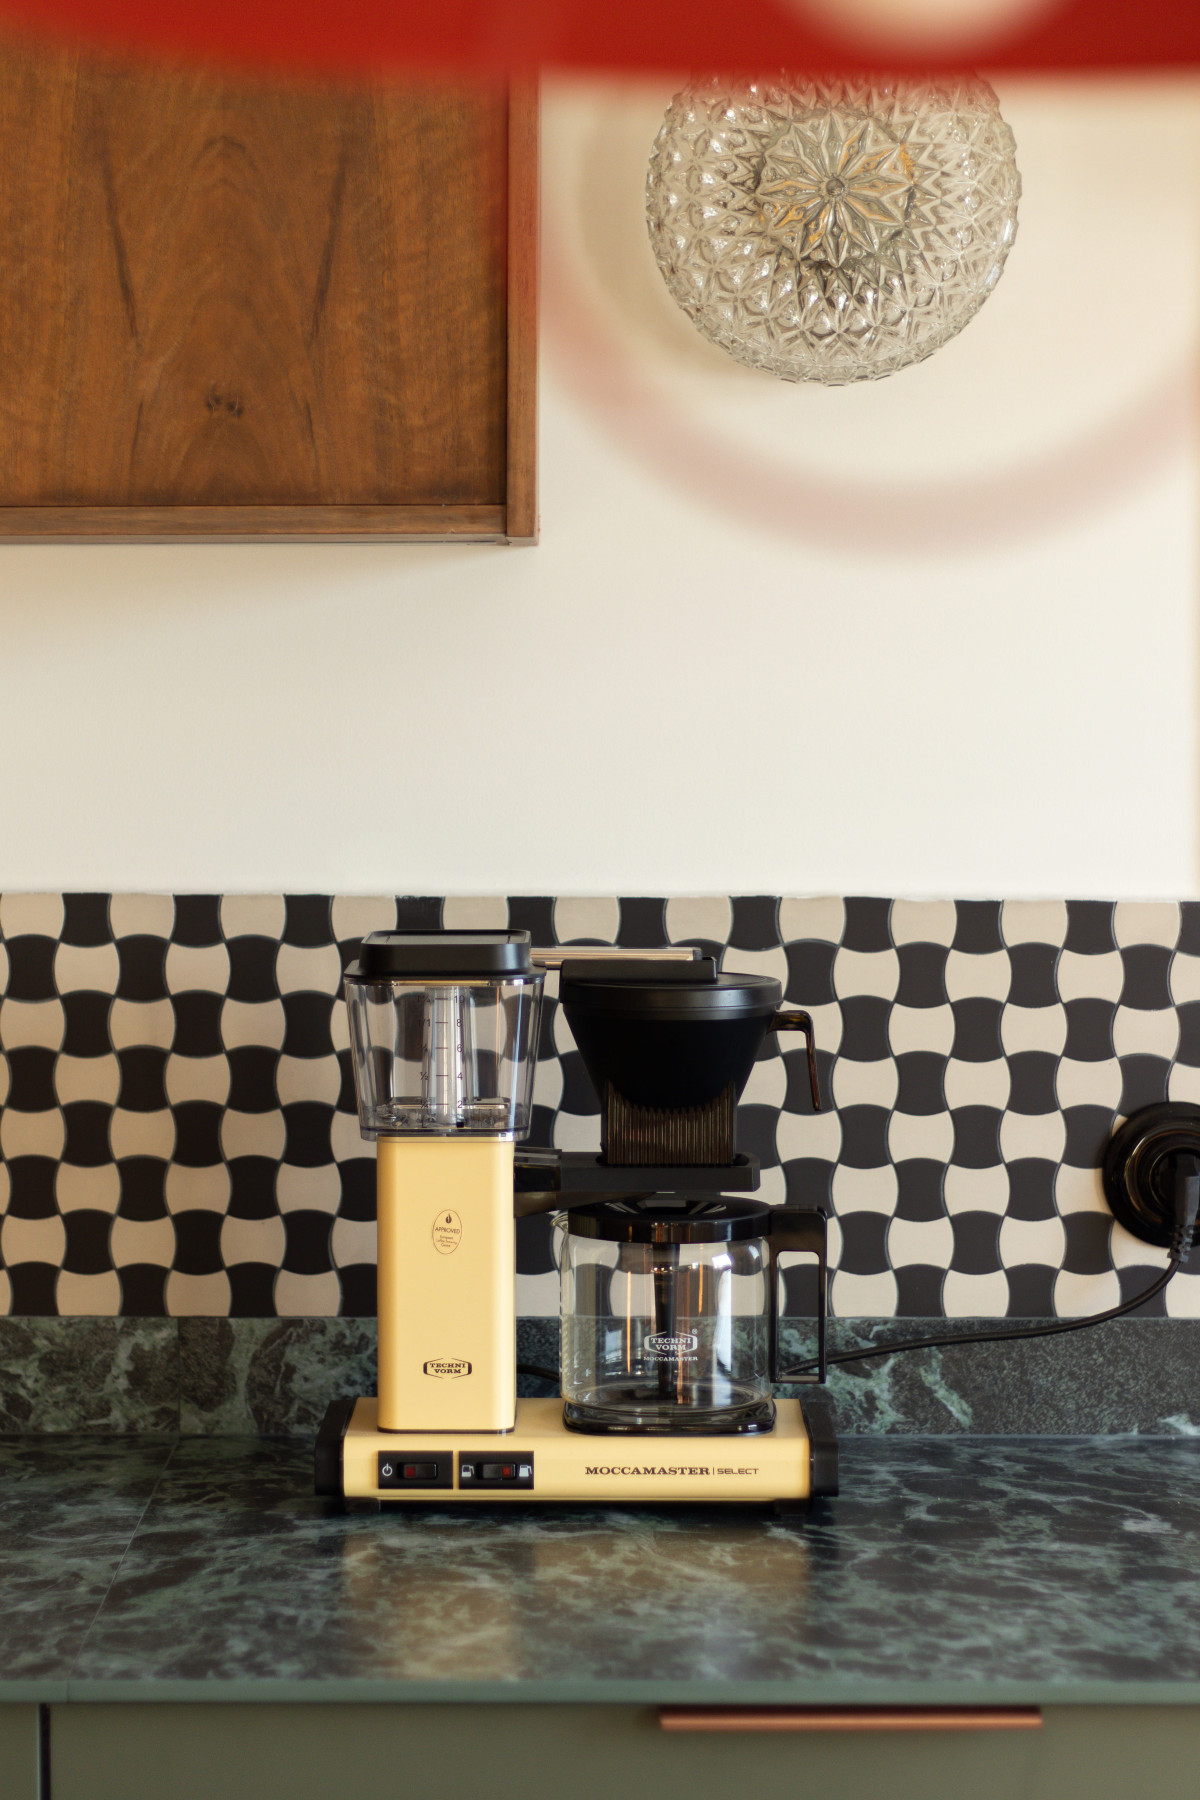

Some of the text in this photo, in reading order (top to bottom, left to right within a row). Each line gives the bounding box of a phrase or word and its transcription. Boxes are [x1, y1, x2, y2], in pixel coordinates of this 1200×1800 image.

[454, 994, 465, 1004] 10
[456, 1018, 463, 1028] 8
[456, 1043, 463, 1053] 6
[456, 1071, 463, 1081] 4
[457, 1099, 463, 1109] 2
[584, 1466, 760, 1476] MOCCAMASTER SELECT
